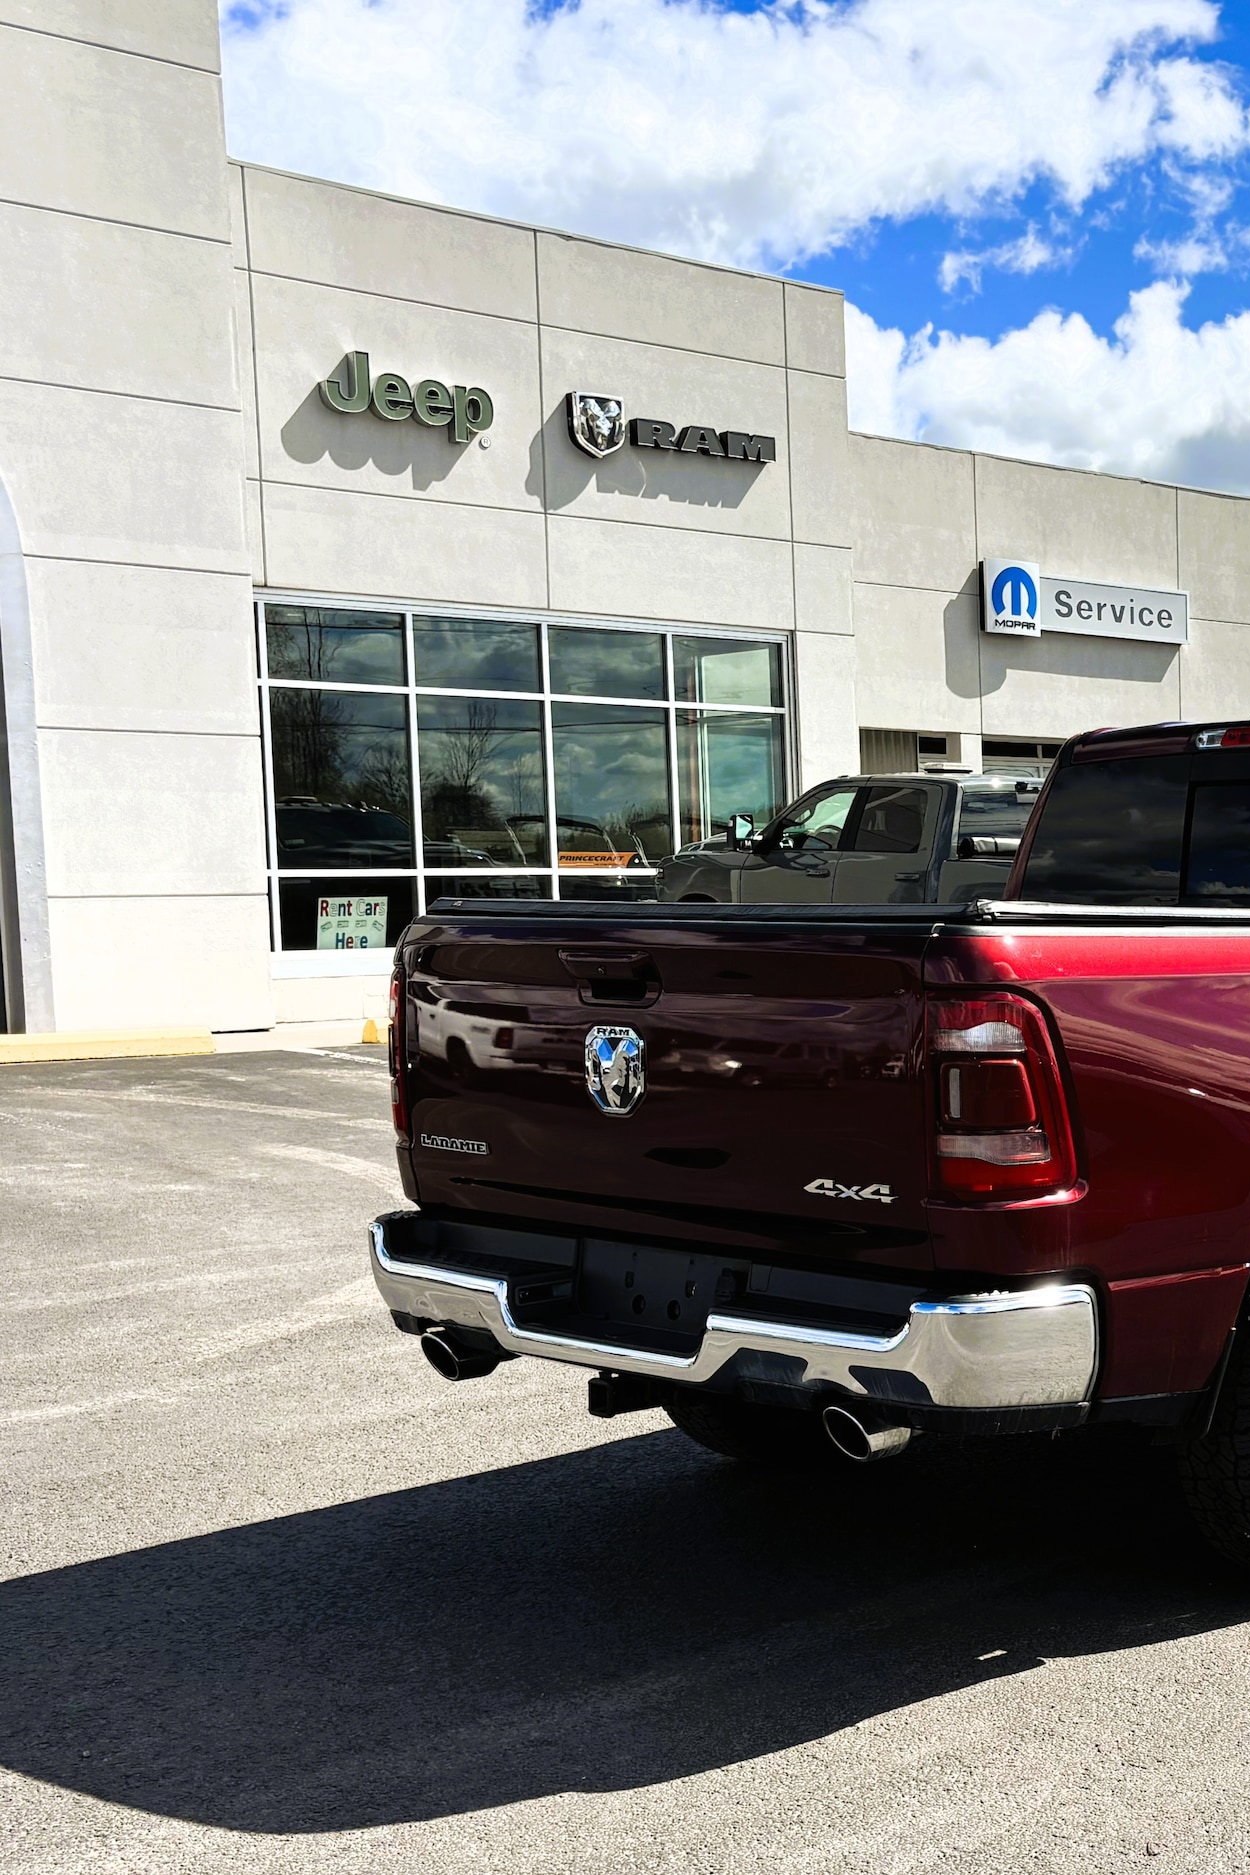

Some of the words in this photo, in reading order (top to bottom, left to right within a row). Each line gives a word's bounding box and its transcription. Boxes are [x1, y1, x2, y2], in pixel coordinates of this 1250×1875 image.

[317, 350, 495, 444] Jeep
[629, 417, 777, 464] RAM
[1054, 589, 1173, 629] Service
[994, 618, 1037, 631] MOPAR
[320, 899, 353, 917] Rent
[356, 898, 386, 916] Cars
[335, 932, 368, 949] Here
[596, 1027, 630, 1037] RAM
[420, 1133, 488, 1155] LARAMIE
[803, 1178, 899, 1204] 4x4
